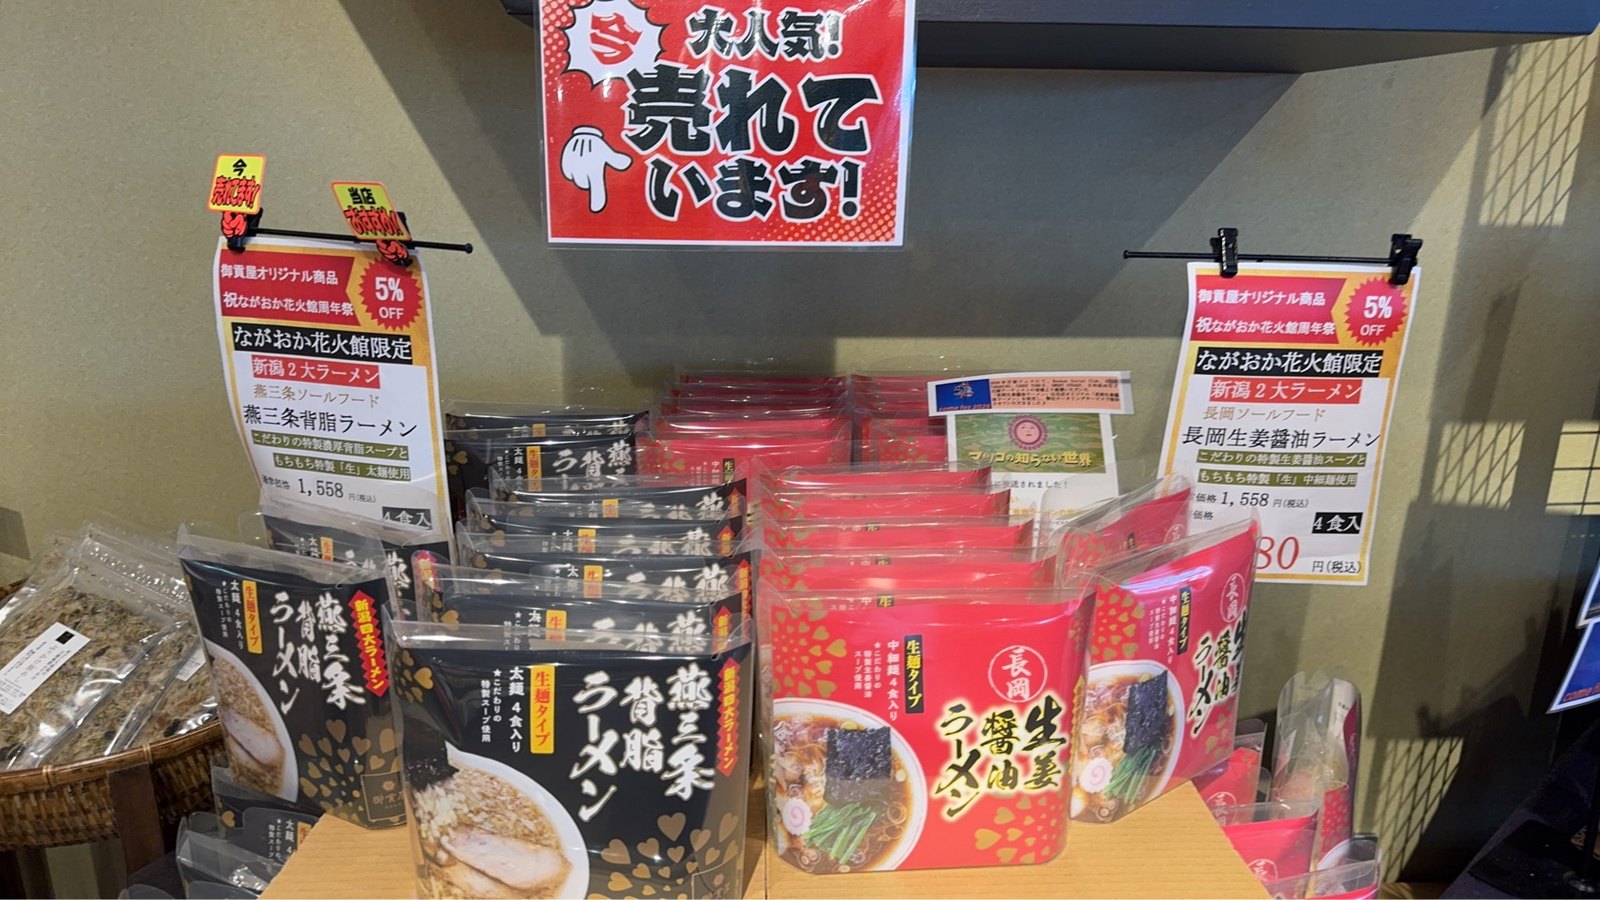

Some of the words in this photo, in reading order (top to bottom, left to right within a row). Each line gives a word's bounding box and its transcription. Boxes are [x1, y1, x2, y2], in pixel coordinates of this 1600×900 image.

[590, 11, 643, 64] 今
[688, 9, 841, 59] 大人気!
[626, 64, 878, 152] 売れて
[232, 158, 247, 176] 今
[347, 187, 376, 205] 当店
[648, 158, 860, 219] います!
[375, 277, 404, 302] 5%
[223, 291, 354, 316] 祝ながおか花火館周年祭
[378, 307, 404, 319] OFF
[1363, 295, 1393, 319] 5%
[1196, 317, 1335, 336] 祝ながおか花火館周年祭
[1359, 324, 1386, 336] OFF
[234, 327, 412, 360] ながおか花火館限定
[1197, 351, 1383, 374] ながおか花火館限定
[253, 384, 379, 408] 燕三条ソールフード
[243, 405, 417, 437] 燕三条背脂ラーメン
[1203, 406, 1326, 422] 長岡ソールフード
[253, 433, 408, 459] こだわりの特製濃厚背脂スープと
[1182, 426, 1381, 449] 長岡生姜醤油ラーメン
[298, 478, 344, 498] 1,558
[1193, 493, 1217, 504] 価格
[1221, 491, 1270, 507] 1,558
[1191, 511, 1214, 520] 価格
[1313, 514, 1361, 532] 4食入
[1312, 560, 1362, 574] 円(税込)
[269, 591, 301, 715] ラーメン
[906, 639, 923, 709] 生麺タイプ
[1002, 647, 1031, 700] 長岡
[535, 670, 551, 747] 生麺タイプ
[620, 675, 665, 774] 背脂
[661, 662, 715, 801] 燕三条
[569, 670, 620, 823] ラーメン
[1021, 694, 1067, 791] 生姜
[935, 703, 981, 818] ラーメン
